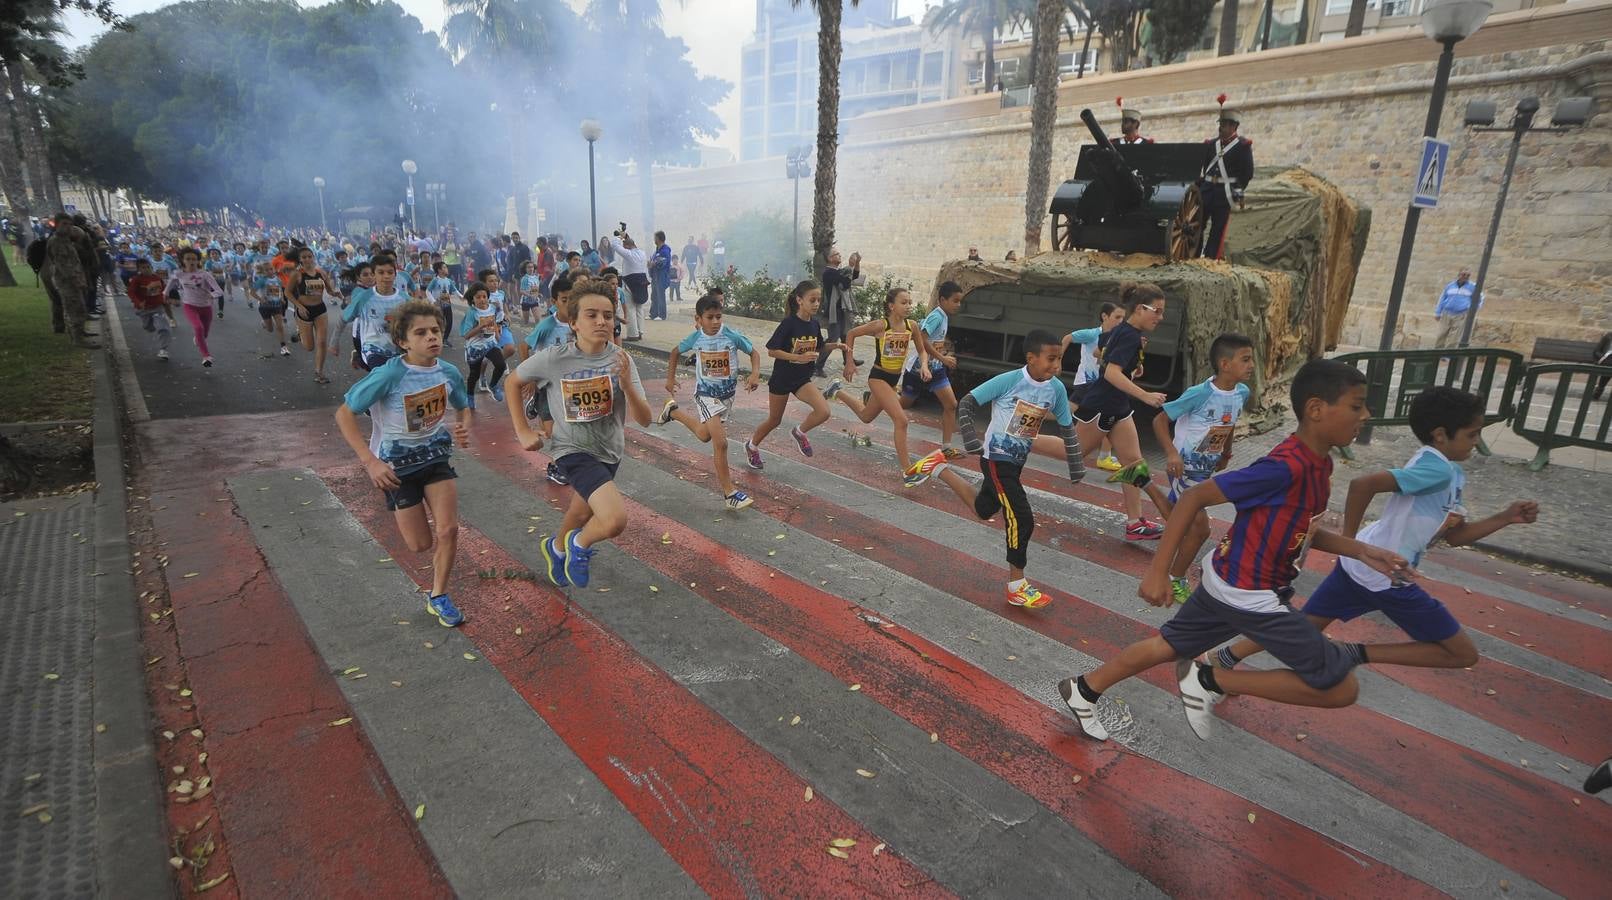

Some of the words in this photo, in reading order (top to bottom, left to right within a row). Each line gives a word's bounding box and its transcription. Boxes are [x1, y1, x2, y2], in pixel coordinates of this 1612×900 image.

[890, 340, 909, 349] 5100
[706, 359, 729, 368] 5280
[572, 389, 610, 406] 5093
